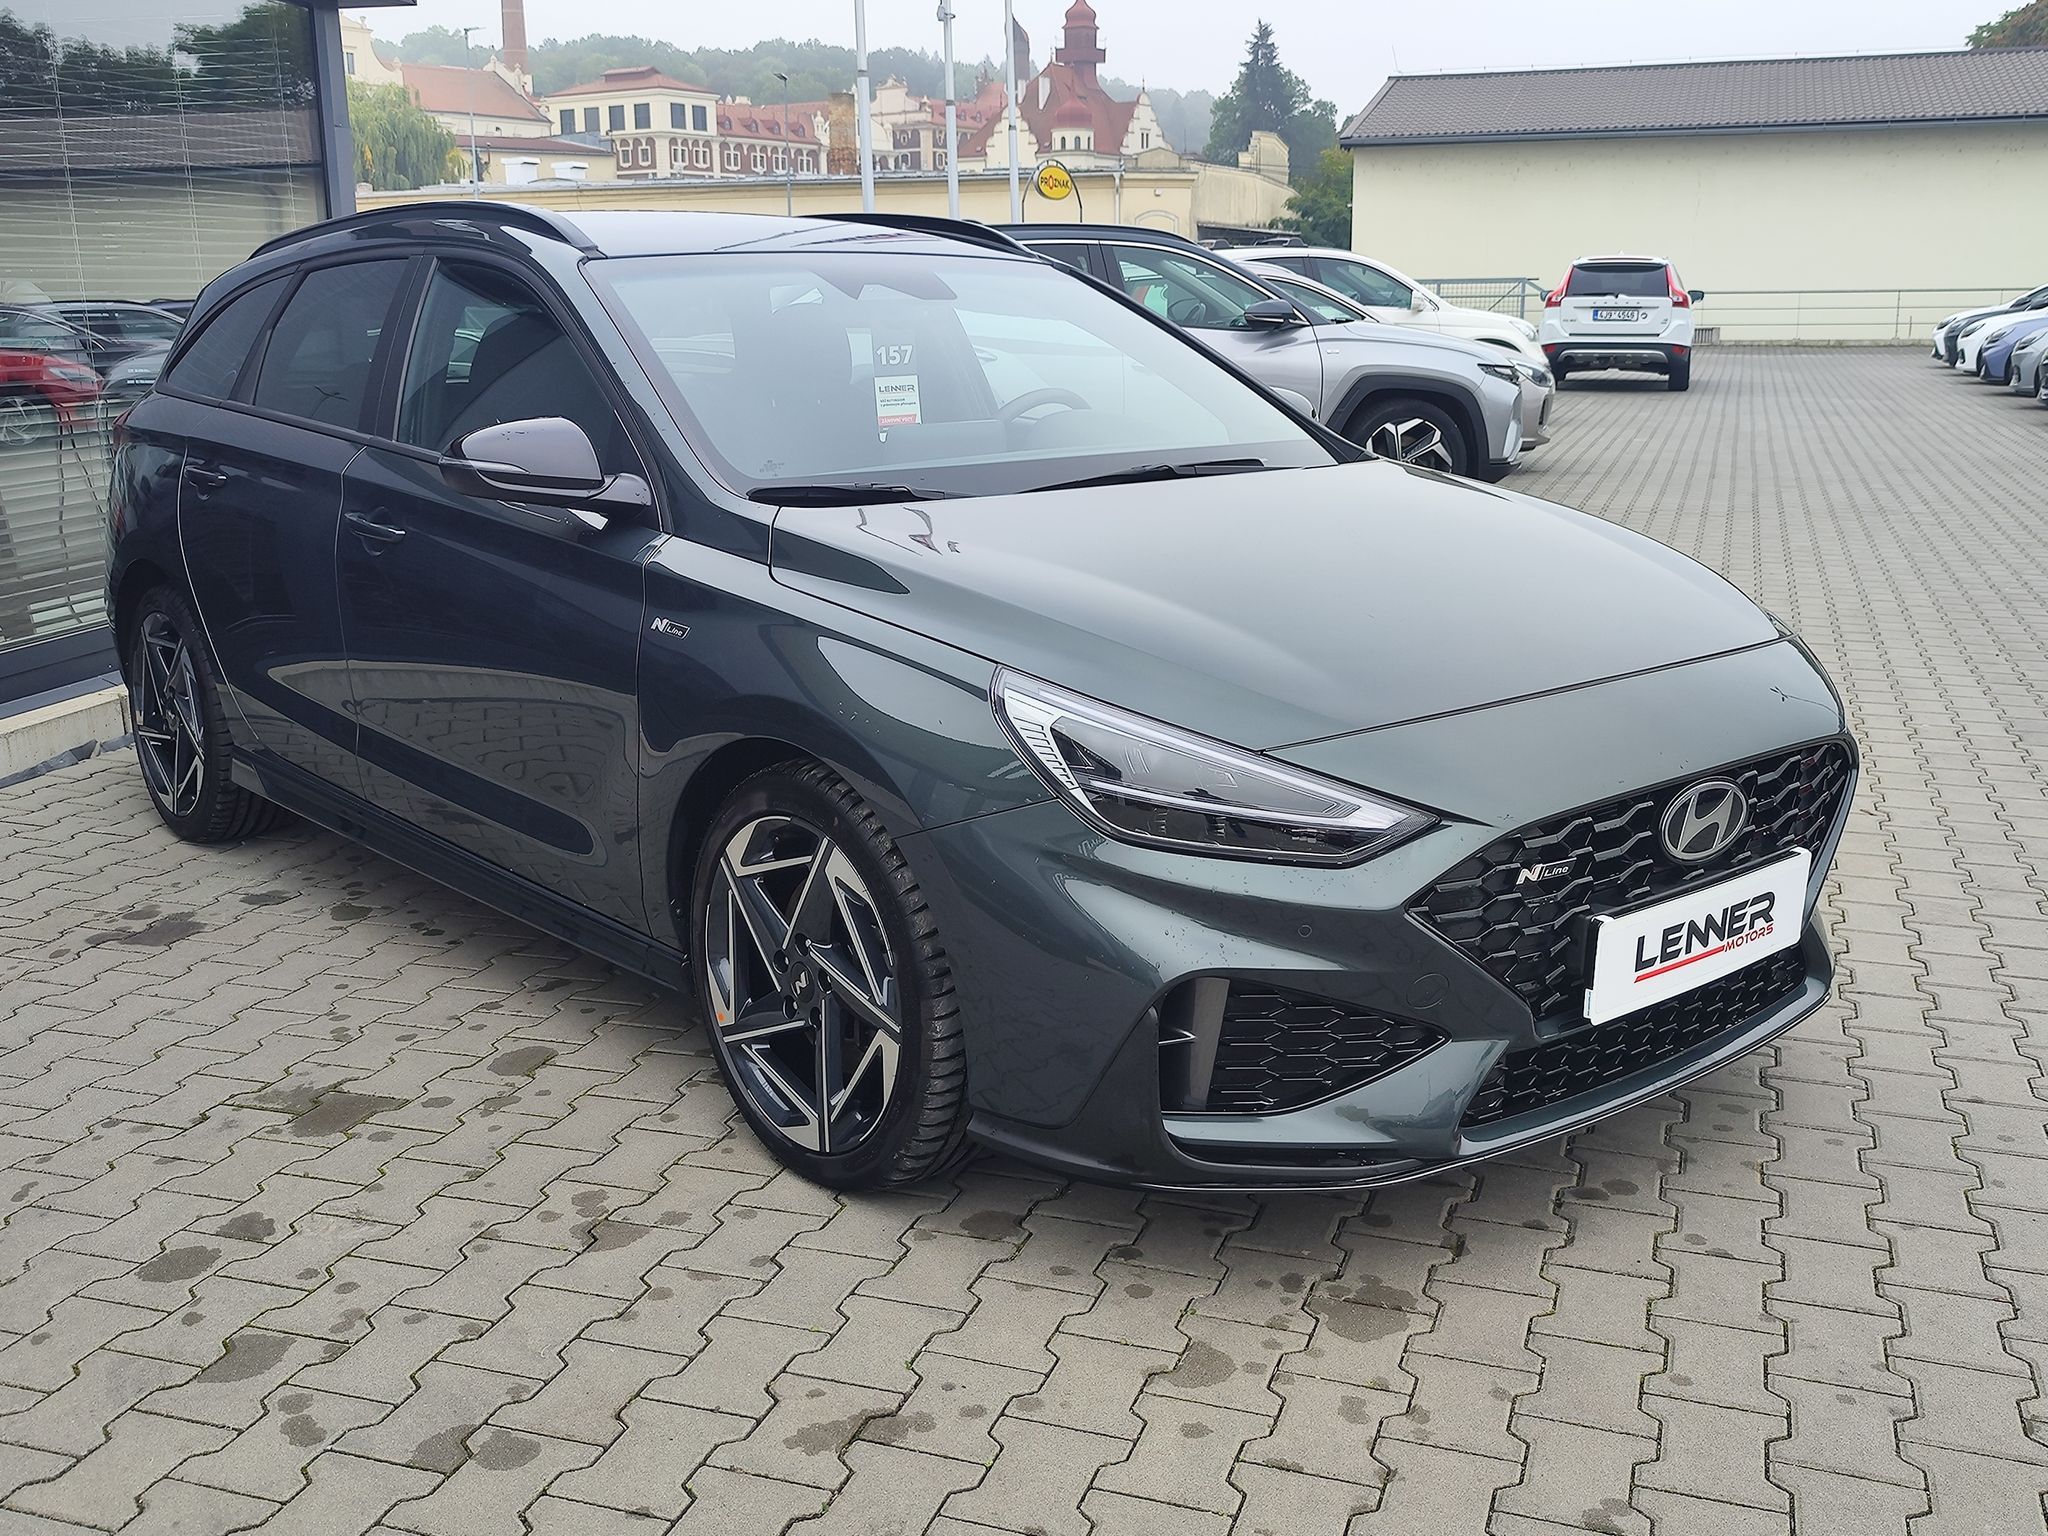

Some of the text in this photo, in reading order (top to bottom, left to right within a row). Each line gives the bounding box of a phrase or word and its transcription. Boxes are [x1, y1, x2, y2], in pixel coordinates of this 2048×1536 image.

[876, 344, 913, 365] 157
[650, 617, 683, 636] N Line
[1516, 864, 1569, 885] N Line
[1634, 891, 1776, 973] LENNER
[1724, 923, 1774, 953] MOTORS
